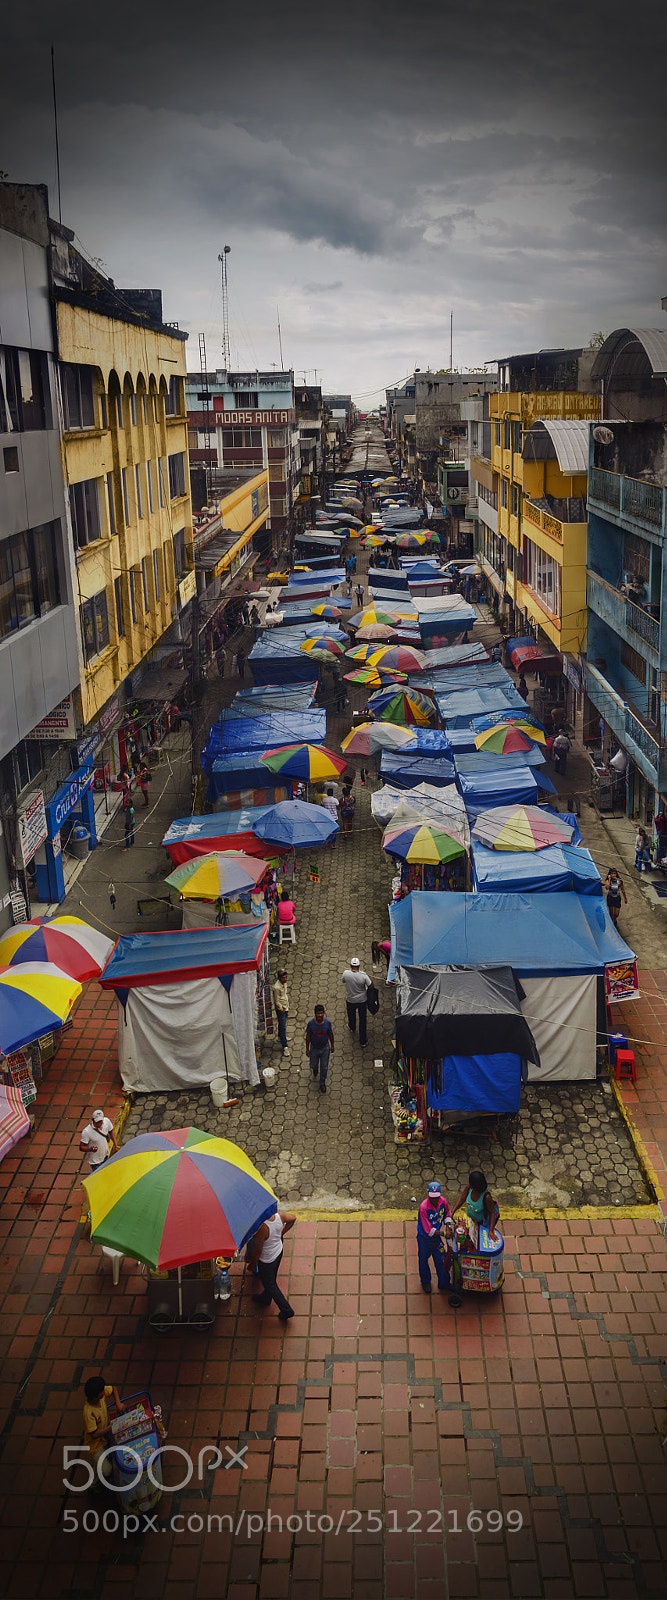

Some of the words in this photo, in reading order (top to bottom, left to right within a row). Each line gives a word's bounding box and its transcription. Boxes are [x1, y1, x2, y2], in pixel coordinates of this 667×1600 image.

[215, 412, 253, 424] MODAS
[256, 411, 288, 423] ANITA
[55, 795, 70, 824] Cruz
